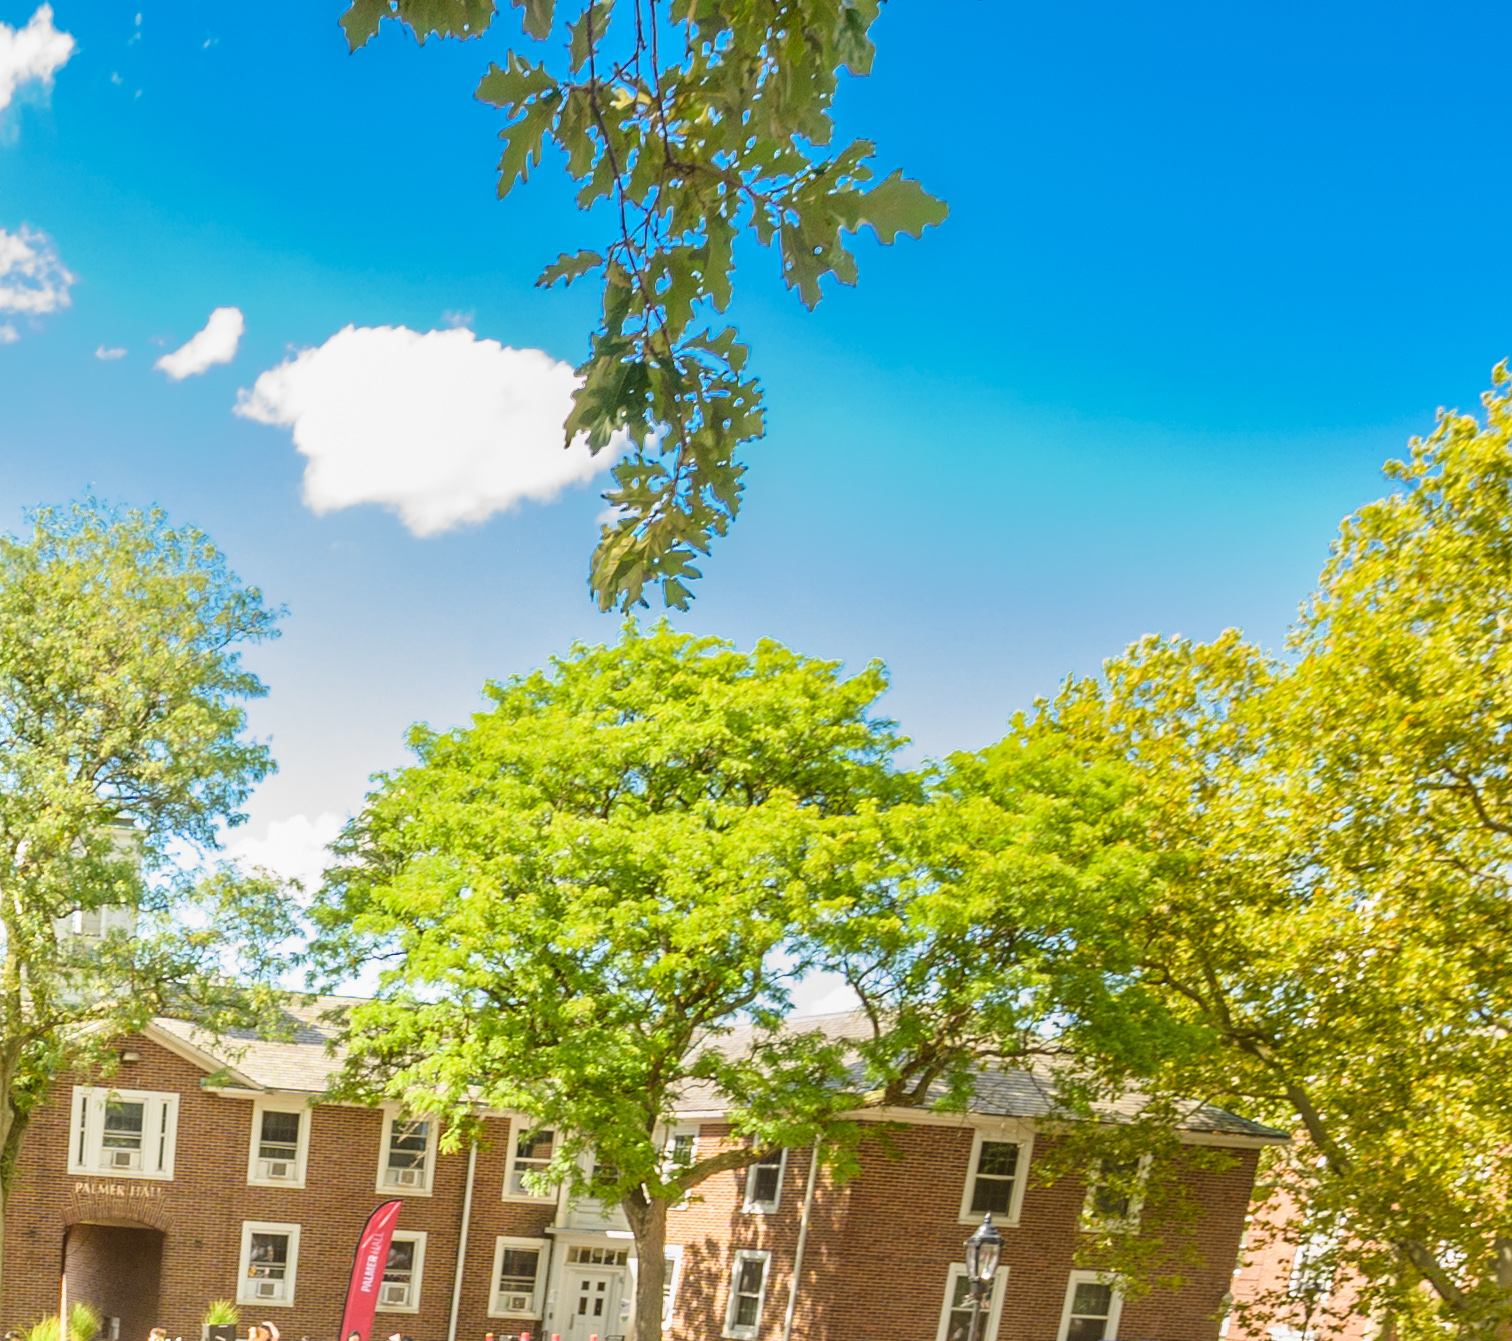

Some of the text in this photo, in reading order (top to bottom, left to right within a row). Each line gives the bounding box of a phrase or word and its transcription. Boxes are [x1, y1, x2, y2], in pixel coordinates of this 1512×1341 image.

[74, 1181, 162, 1198] PALMER HALL
[360, 1231, 385, 1293] PALMER HALL
